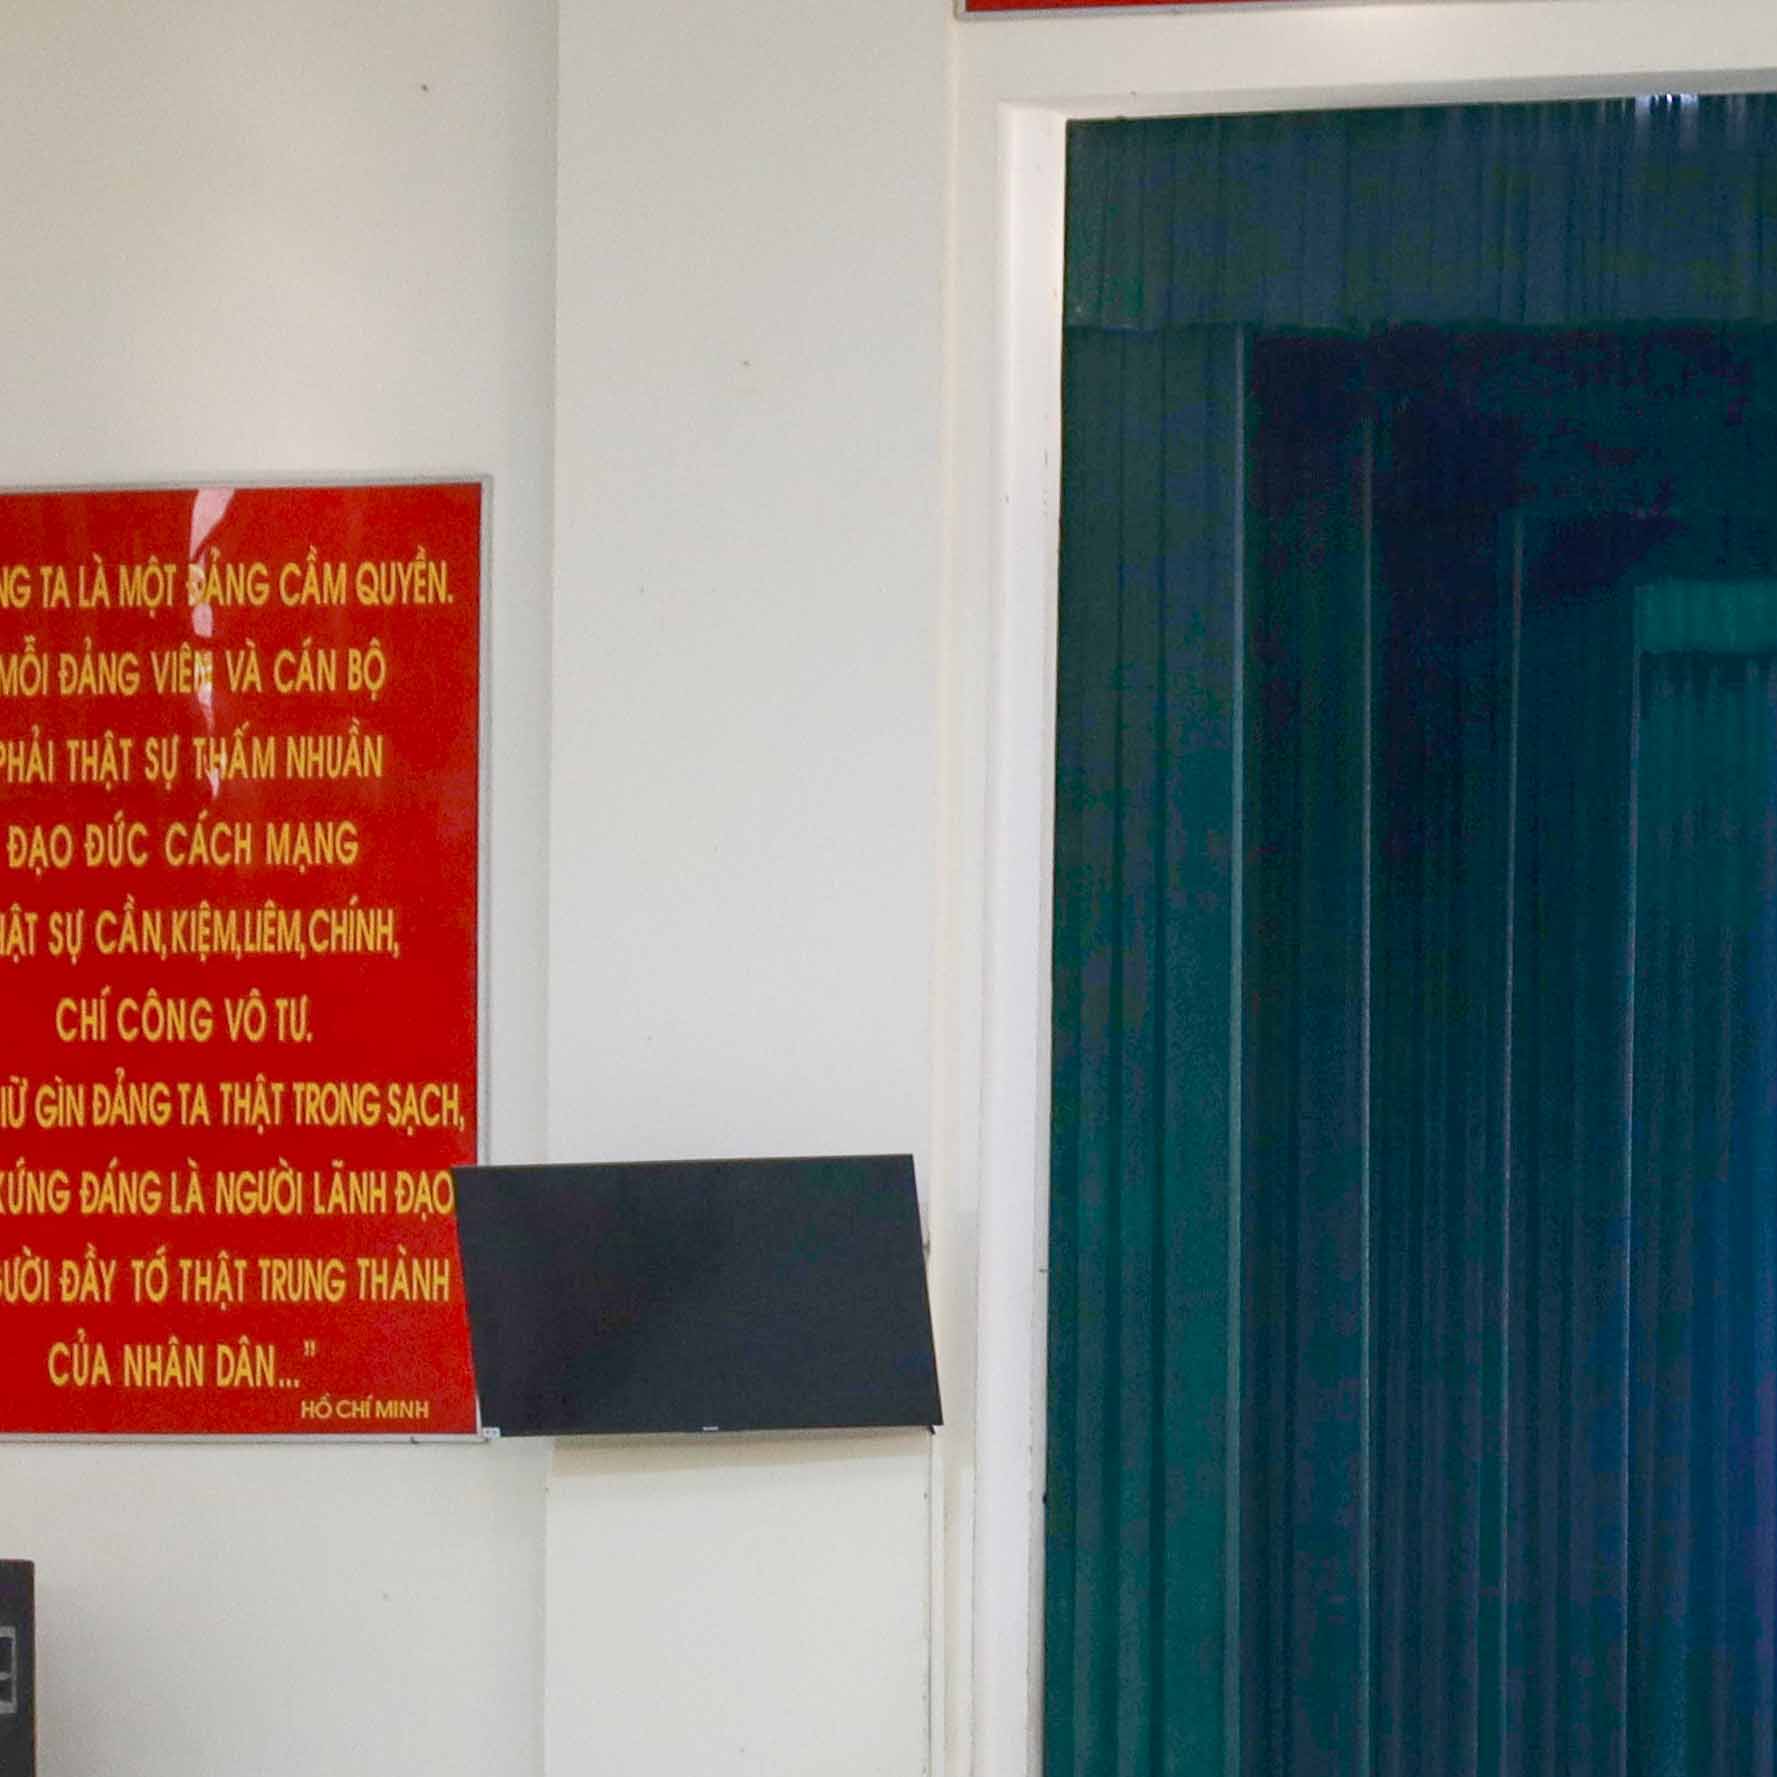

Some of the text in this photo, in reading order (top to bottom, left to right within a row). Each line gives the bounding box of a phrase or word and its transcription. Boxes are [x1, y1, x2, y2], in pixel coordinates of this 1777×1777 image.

[120, 546, 452, 616] MỘT CẦM QUYỀN.
[59, 638, 385, 700] ĐẢNG VÀ CÁN BỘ
[68, 719, 382, 789] THẬT NHUẦN
[8, 811, 358, 874] ĐẠO ĐỨC CÁCH MẠNG
[57, 987, 266, 1041] CHÍ CÔNG VÔ
[36, 1068, 464, 1135] GÌN ĐẢNG THẬT TRONG SẠCH,
[80, 1159, 454, 1220] ĐÁNG NGƯỜI LÃNH ĐẠO
[60, 1245, 449, 1309] ĐẦY TỚ THẬT TRUNG THÀNH
[49, 1329, 203, 1386] CỦA NHÂN
[302, 1396, 428, 1418] HỒ CHÍ MINH
